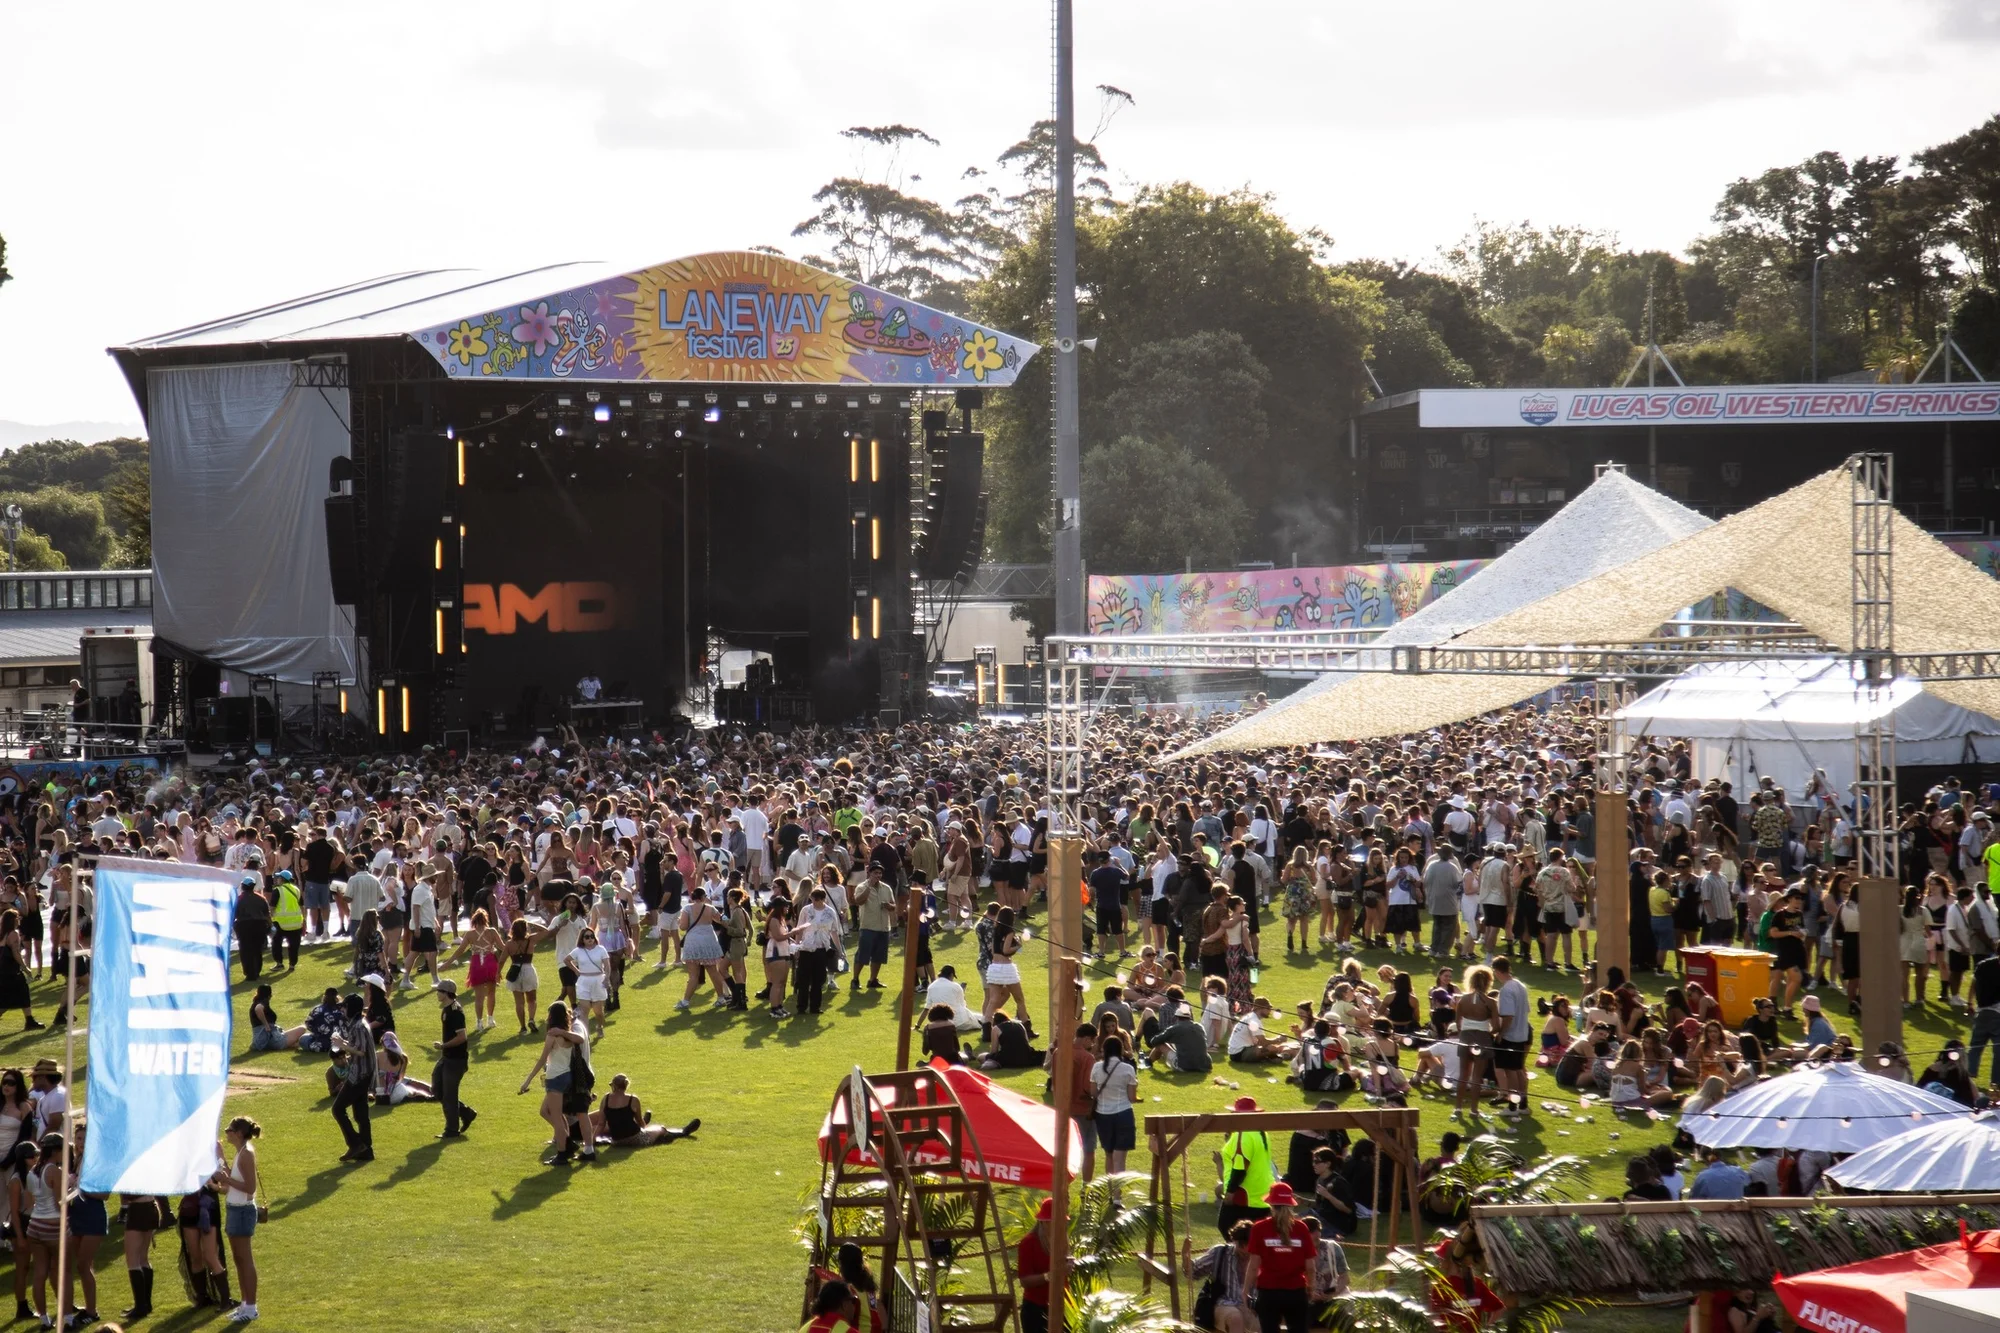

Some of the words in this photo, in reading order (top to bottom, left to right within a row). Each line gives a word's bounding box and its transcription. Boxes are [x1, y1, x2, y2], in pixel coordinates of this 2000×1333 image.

[658, 289, 831, 334] LANEWAY
[685, 327, 768, 360] festival
[1570, 395, 1672, 419] LUCAS
[1673, 394, 1720, 417] OIL
[1724, 393, 1869, 417] WESTERN
[1870, 390, 2000, 416] SPRINGS
[128, 881, 234, 1033] WAI
[128, 1042, 223, 1076] WATER
[1798, 1300, 1860, 1333] FLIGHT
